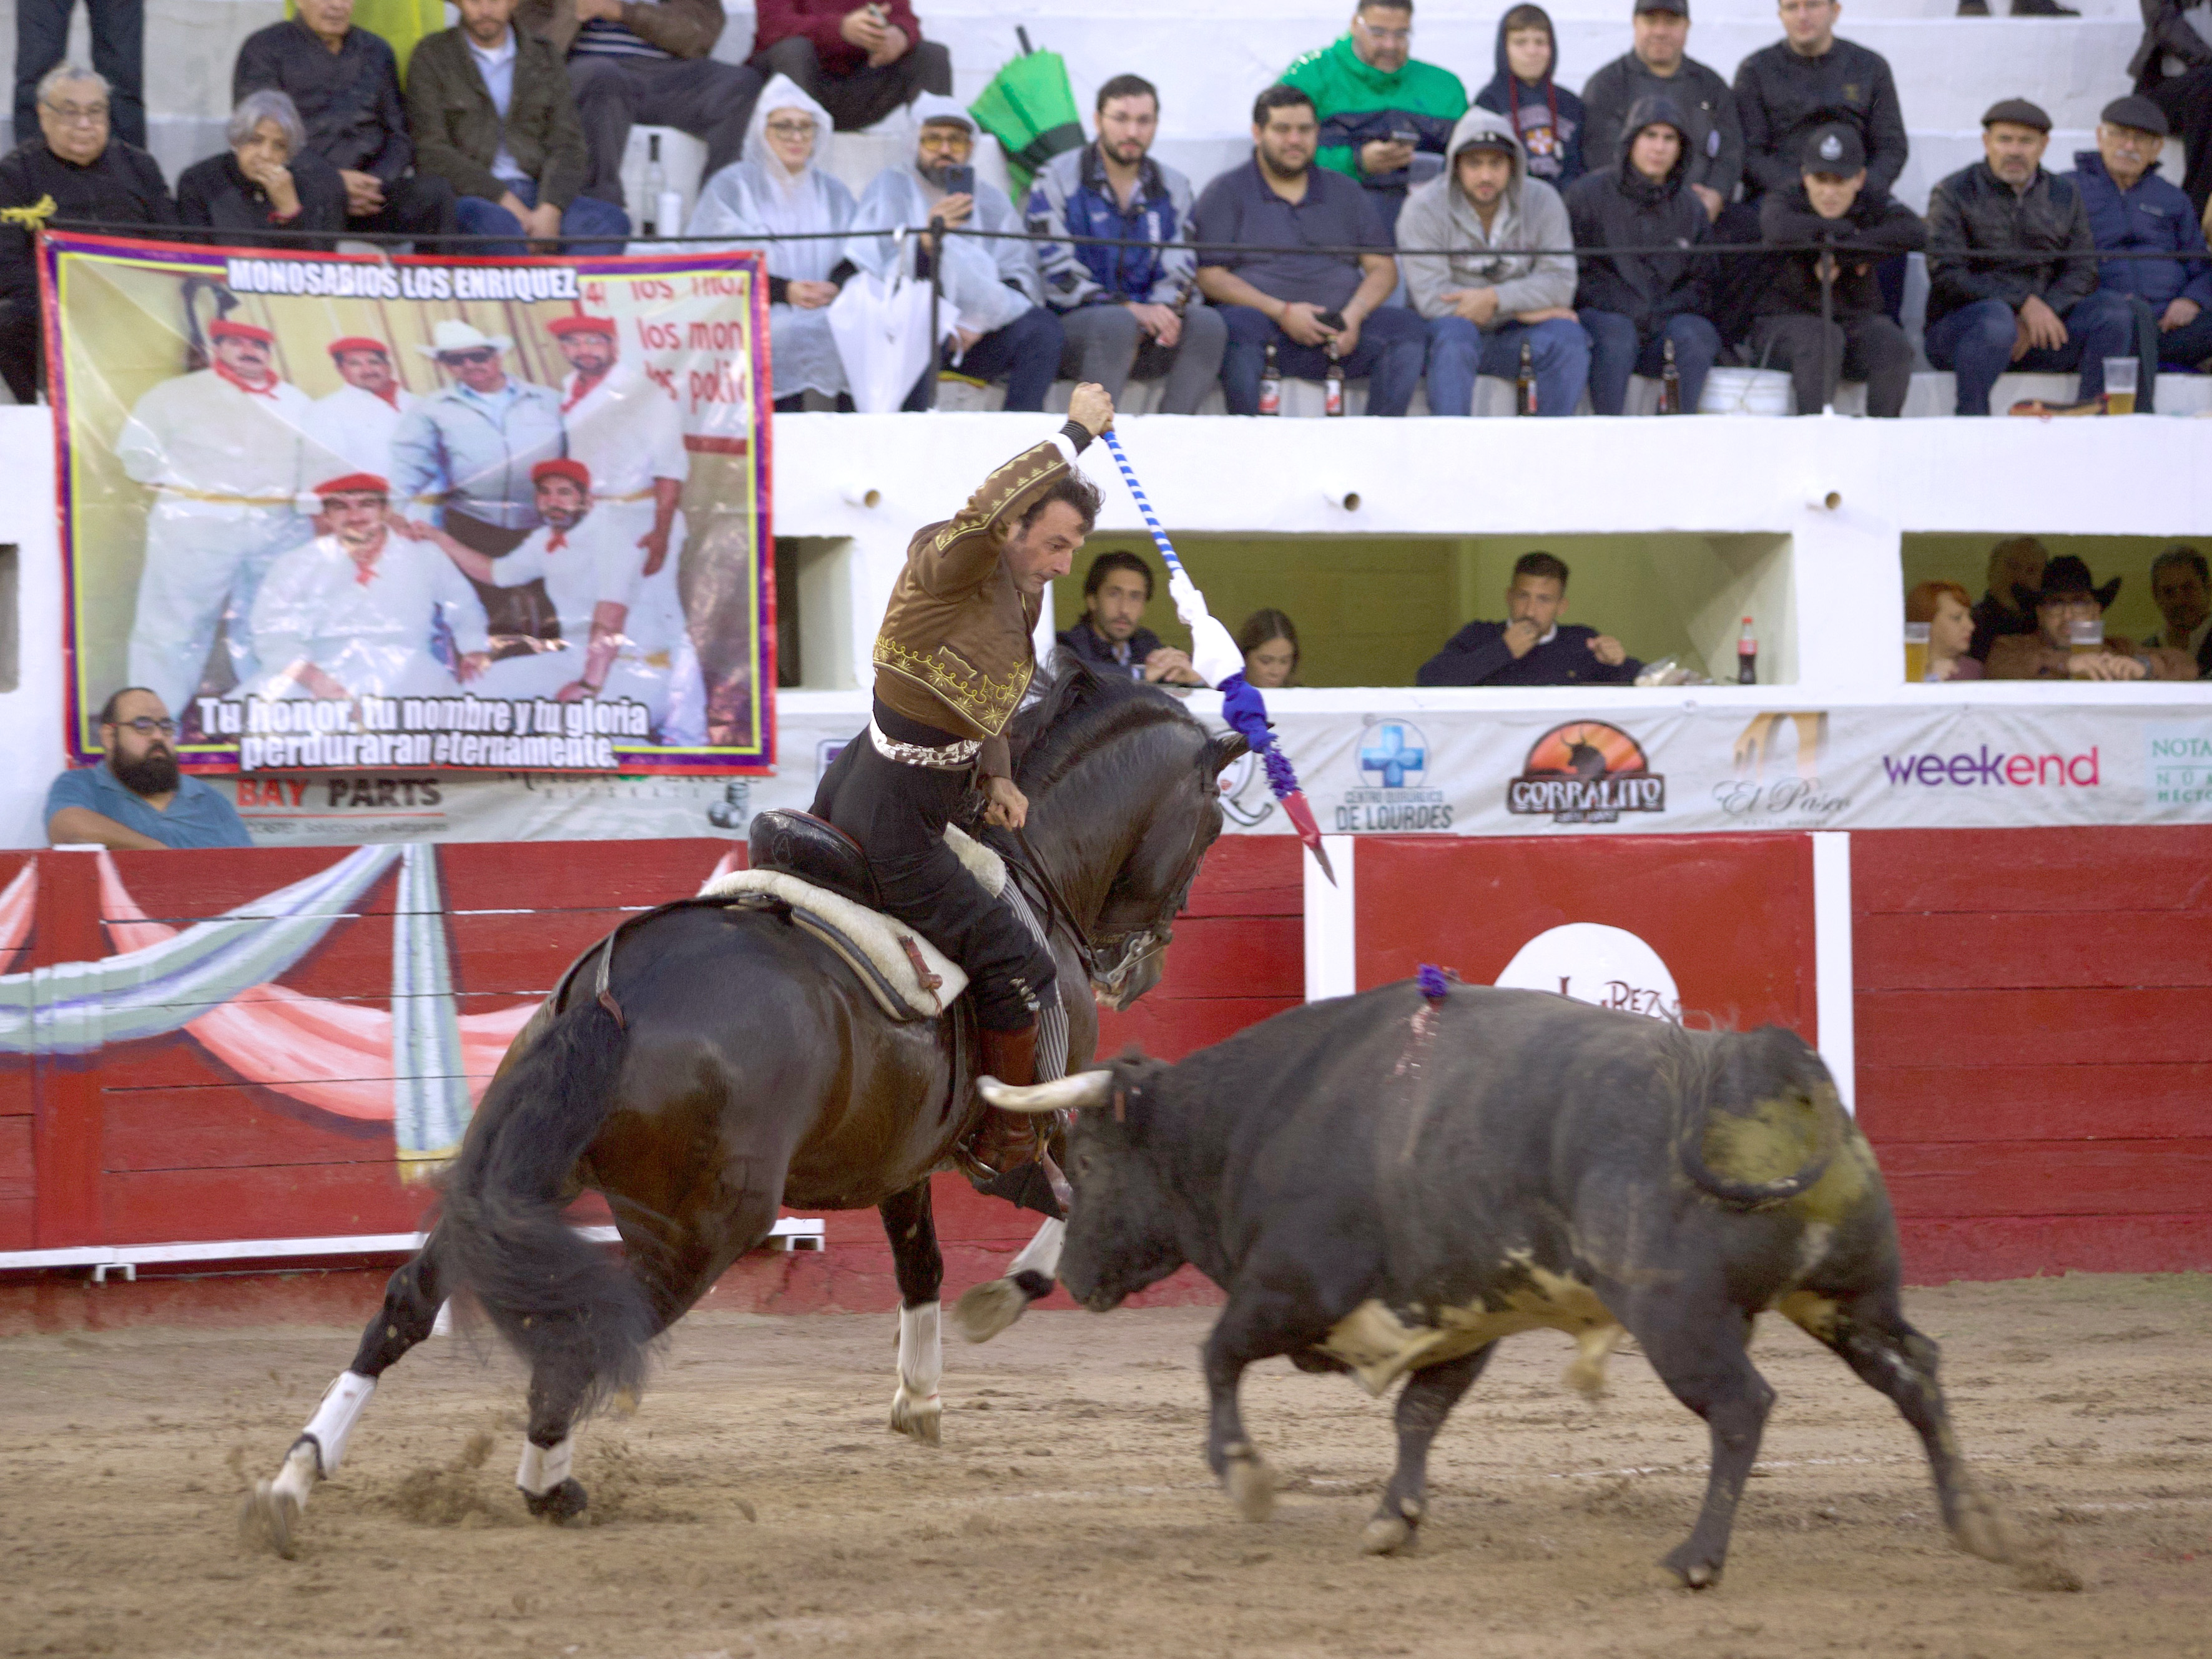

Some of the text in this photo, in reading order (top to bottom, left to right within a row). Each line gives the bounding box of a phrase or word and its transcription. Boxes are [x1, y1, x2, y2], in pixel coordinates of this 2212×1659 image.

[229, 258, 399, 298] MONOSABIOS
[401, 267, 450, 299] LOS
[455, 267, 578, 303] ENRIQUEZ
[636, 317, 681, 350] los
[197, 697, 241, 734] Tu
[360, 696, 398, 731] tu
[403, 694, 512, 732] nombre
[513, 699, 531, 736] y
[533, 697, 561, 733] tu
[564, 696, 649, 737] gloria
[240, 730, 431, 771] perduraran
[1882, 744, 2100, 786] weekend
[235, 779, 443, 807] BAY PARTS
[1512, 778, 1661, 810] CORRALITO
[1335, 803, 1454, 830] DE LOURDES
